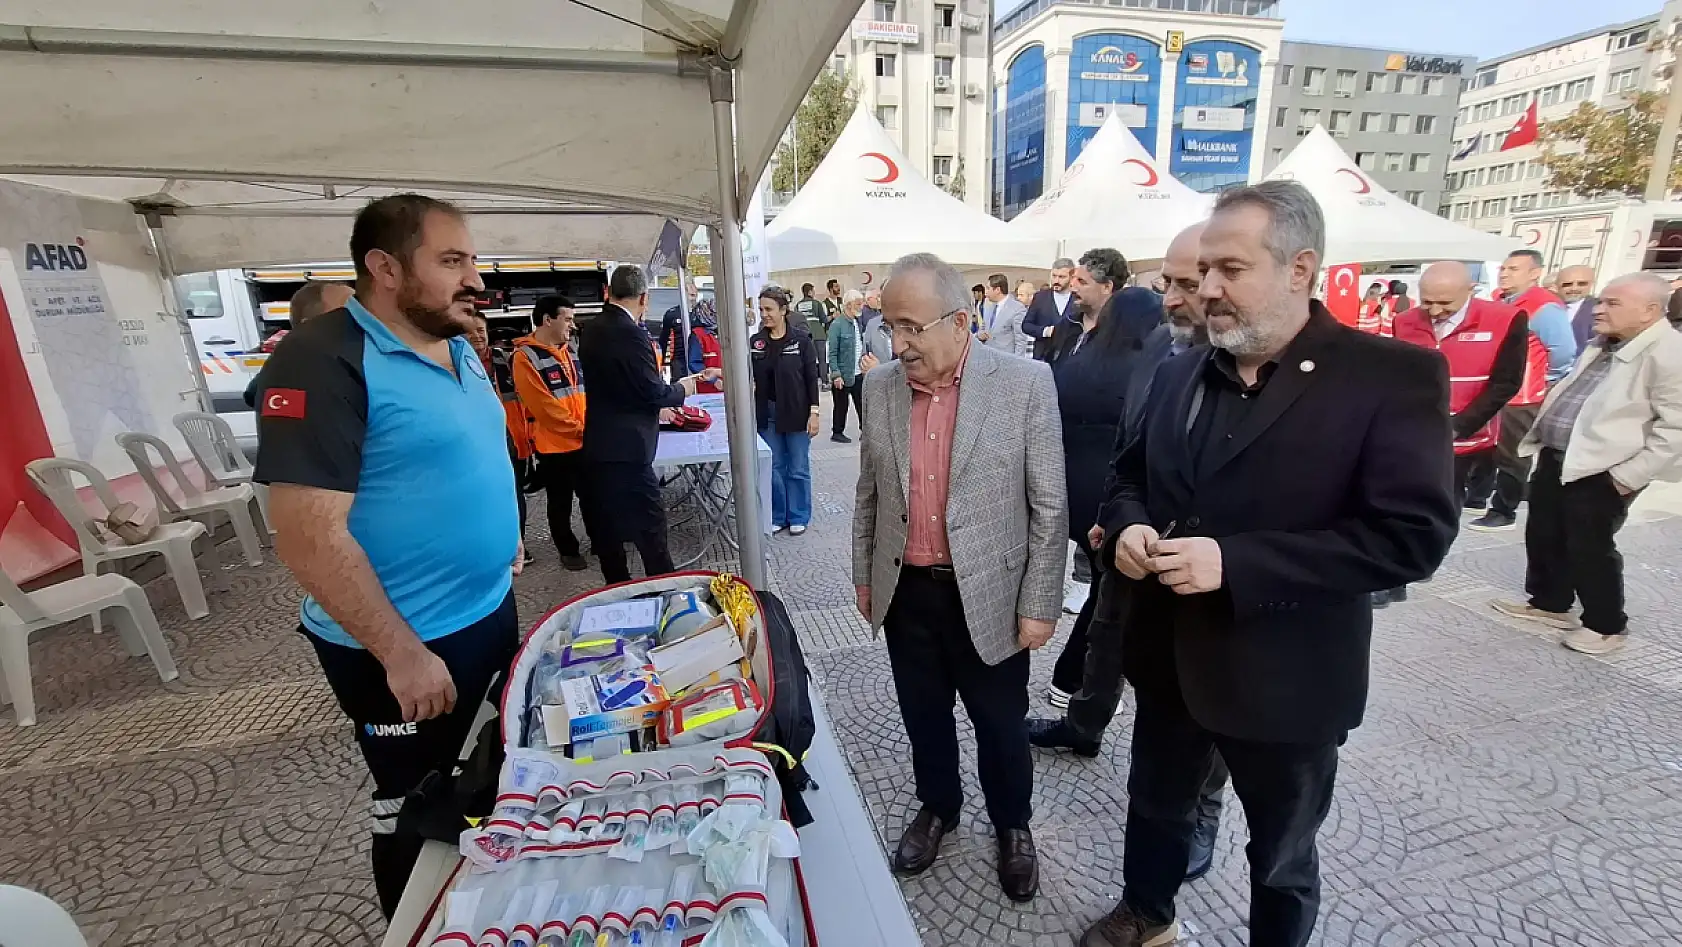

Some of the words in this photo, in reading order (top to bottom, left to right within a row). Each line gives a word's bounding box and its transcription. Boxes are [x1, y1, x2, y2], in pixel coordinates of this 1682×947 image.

[1090, 53, 1125, 64] KANAL
[1125, 51, 1138, 66] S
[26, 242, 88, 271] AFAD
[373, 721, 418, 737] UMKE
